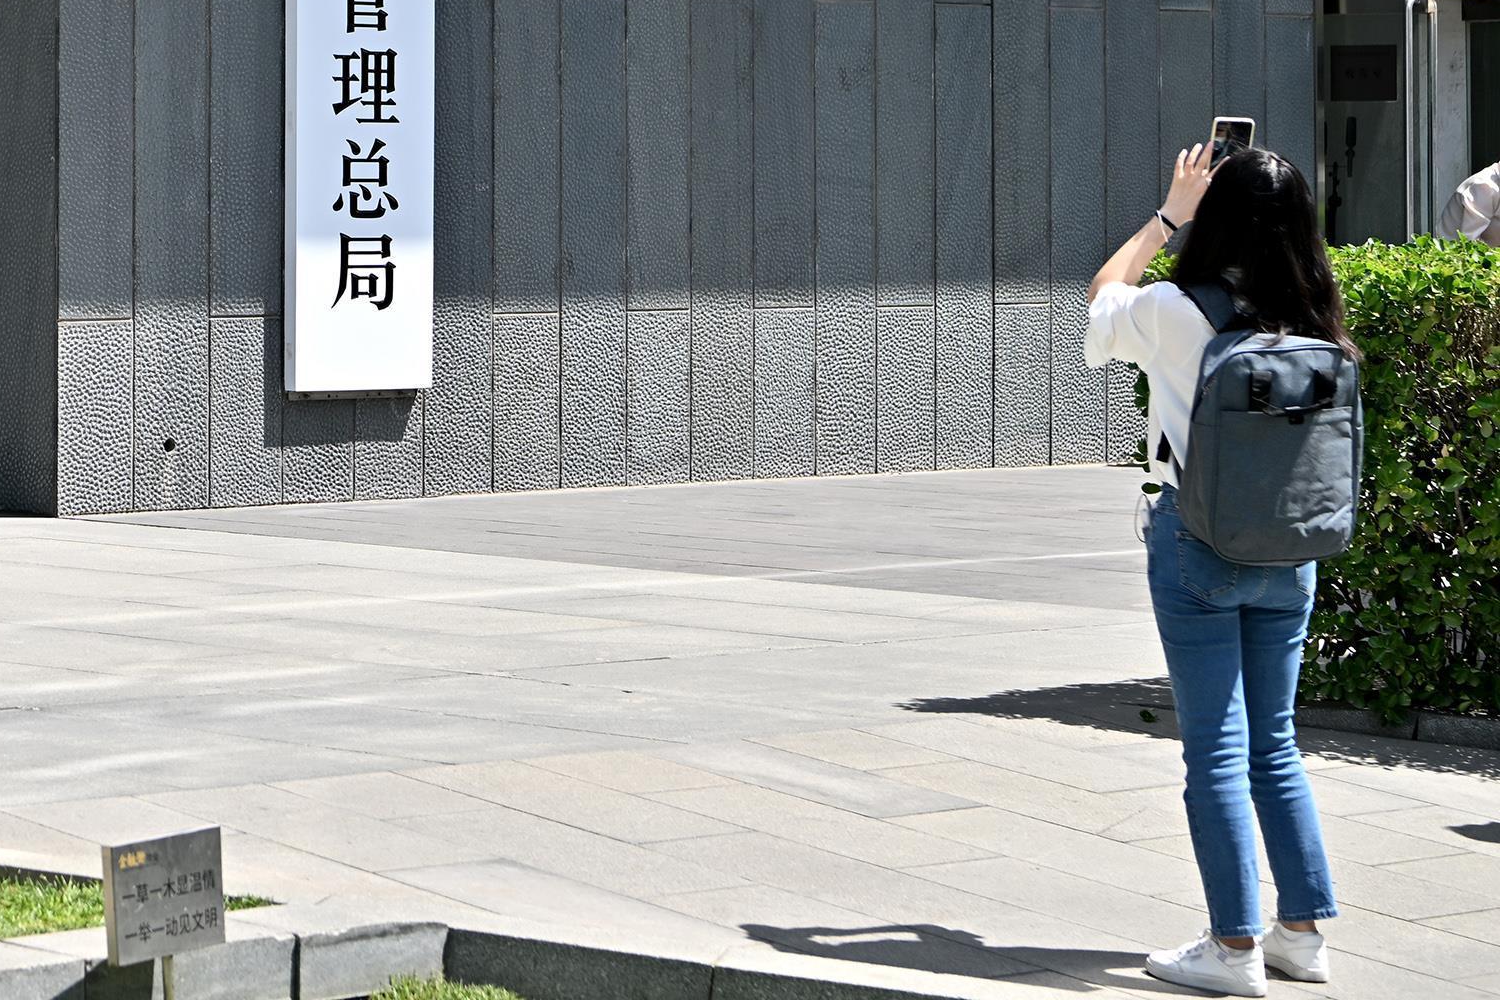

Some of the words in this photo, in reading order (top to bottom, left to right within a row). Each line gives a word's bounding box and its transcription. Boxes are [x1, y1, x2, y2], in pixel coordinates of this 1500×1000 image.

[122, 869, 216, 903] 一草一木显温情
[125, 907, 218, 943] 一举一动见文明
